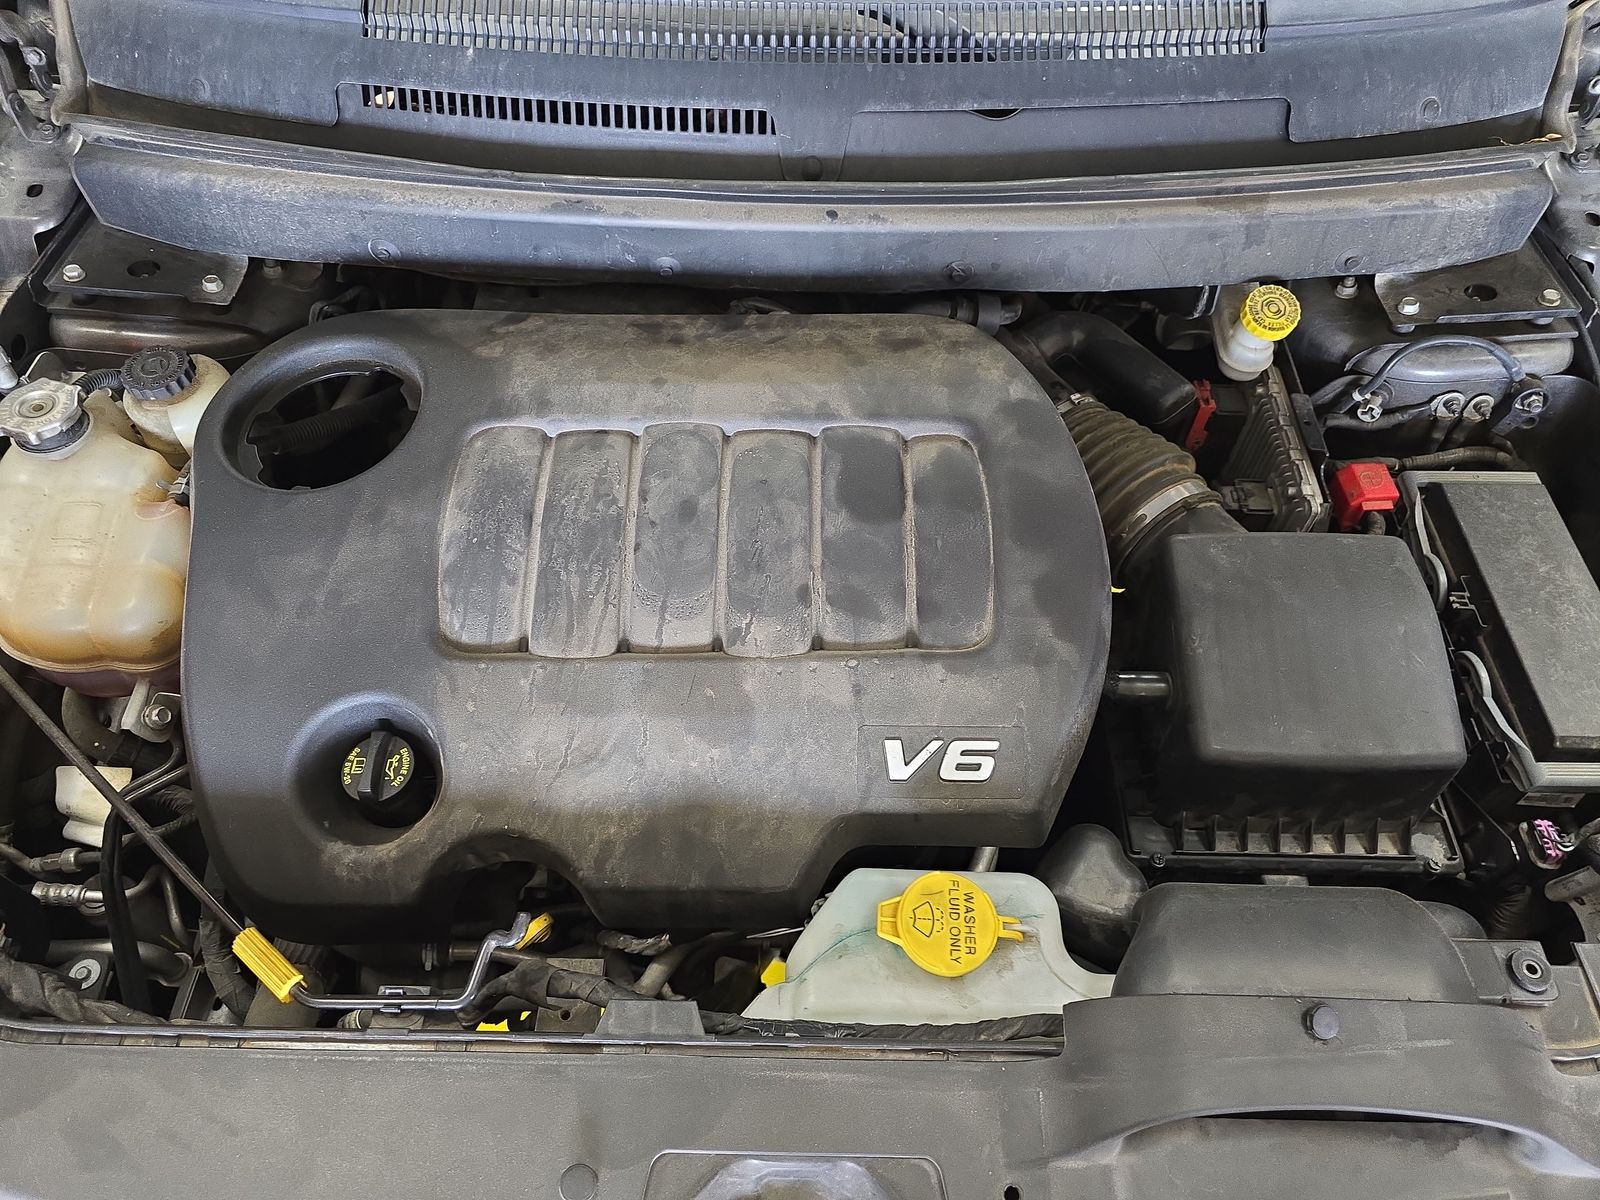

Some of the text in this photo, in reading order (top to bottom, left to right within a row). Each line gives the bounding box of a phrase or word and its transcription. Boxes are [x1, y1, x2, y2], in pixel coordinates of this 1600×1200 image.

[390, 747, 411, 787] ENGINE OIL
[882, 738, 1000, 783] V6
[947, 879, 963, 965] FLUID ONLY
[962, 891, 977, 956] WASHER
